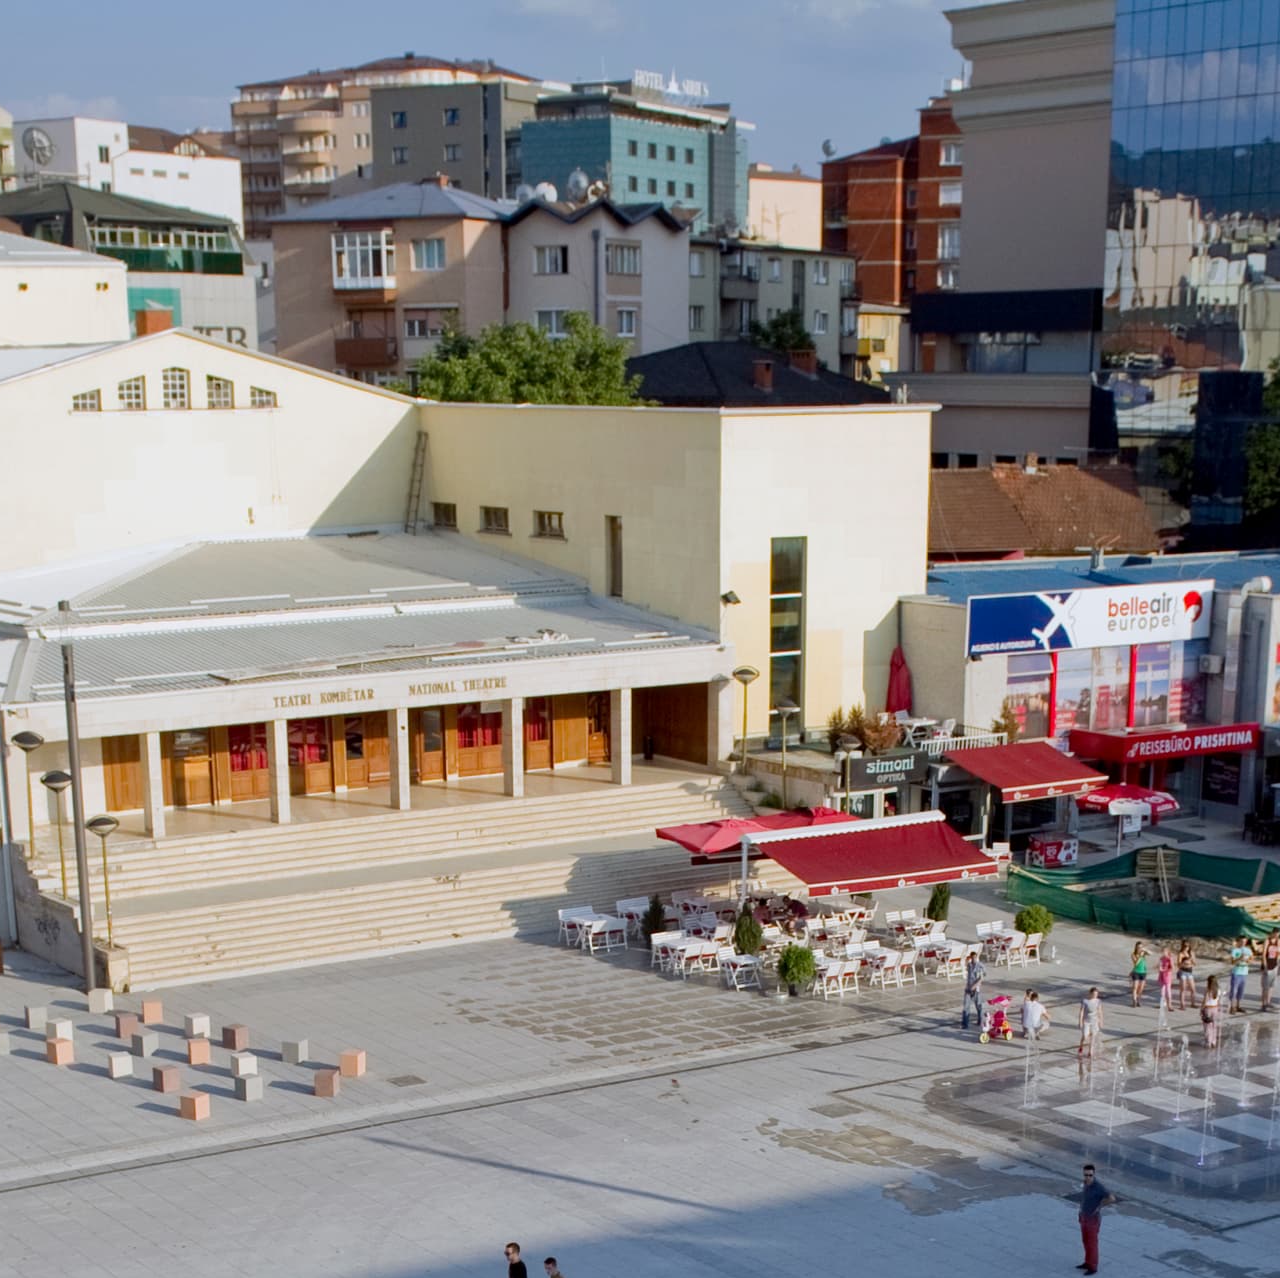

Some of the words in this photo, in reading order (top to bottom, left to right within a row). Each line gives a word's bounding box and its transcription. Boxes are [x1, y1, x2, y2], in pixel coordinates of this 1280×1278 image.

[634, 70, 664, 90] HOTEL
[1107, 613, 1170, 633] europe
[273, 693, 312, 708] TEATRI
[320, 687, 375, 704] KOMBËTAR
[408, 679, 457, 696] NATIONAL
[463, 676, 508, 692] THEATRE
[1139, 735, 1192, 756] REISEBÜRO
[1194, 730, 1253, 750] PRISHTINA
[866, 755, 915, 774] simoni
[876, 772, 906, 783] OPTIKA
